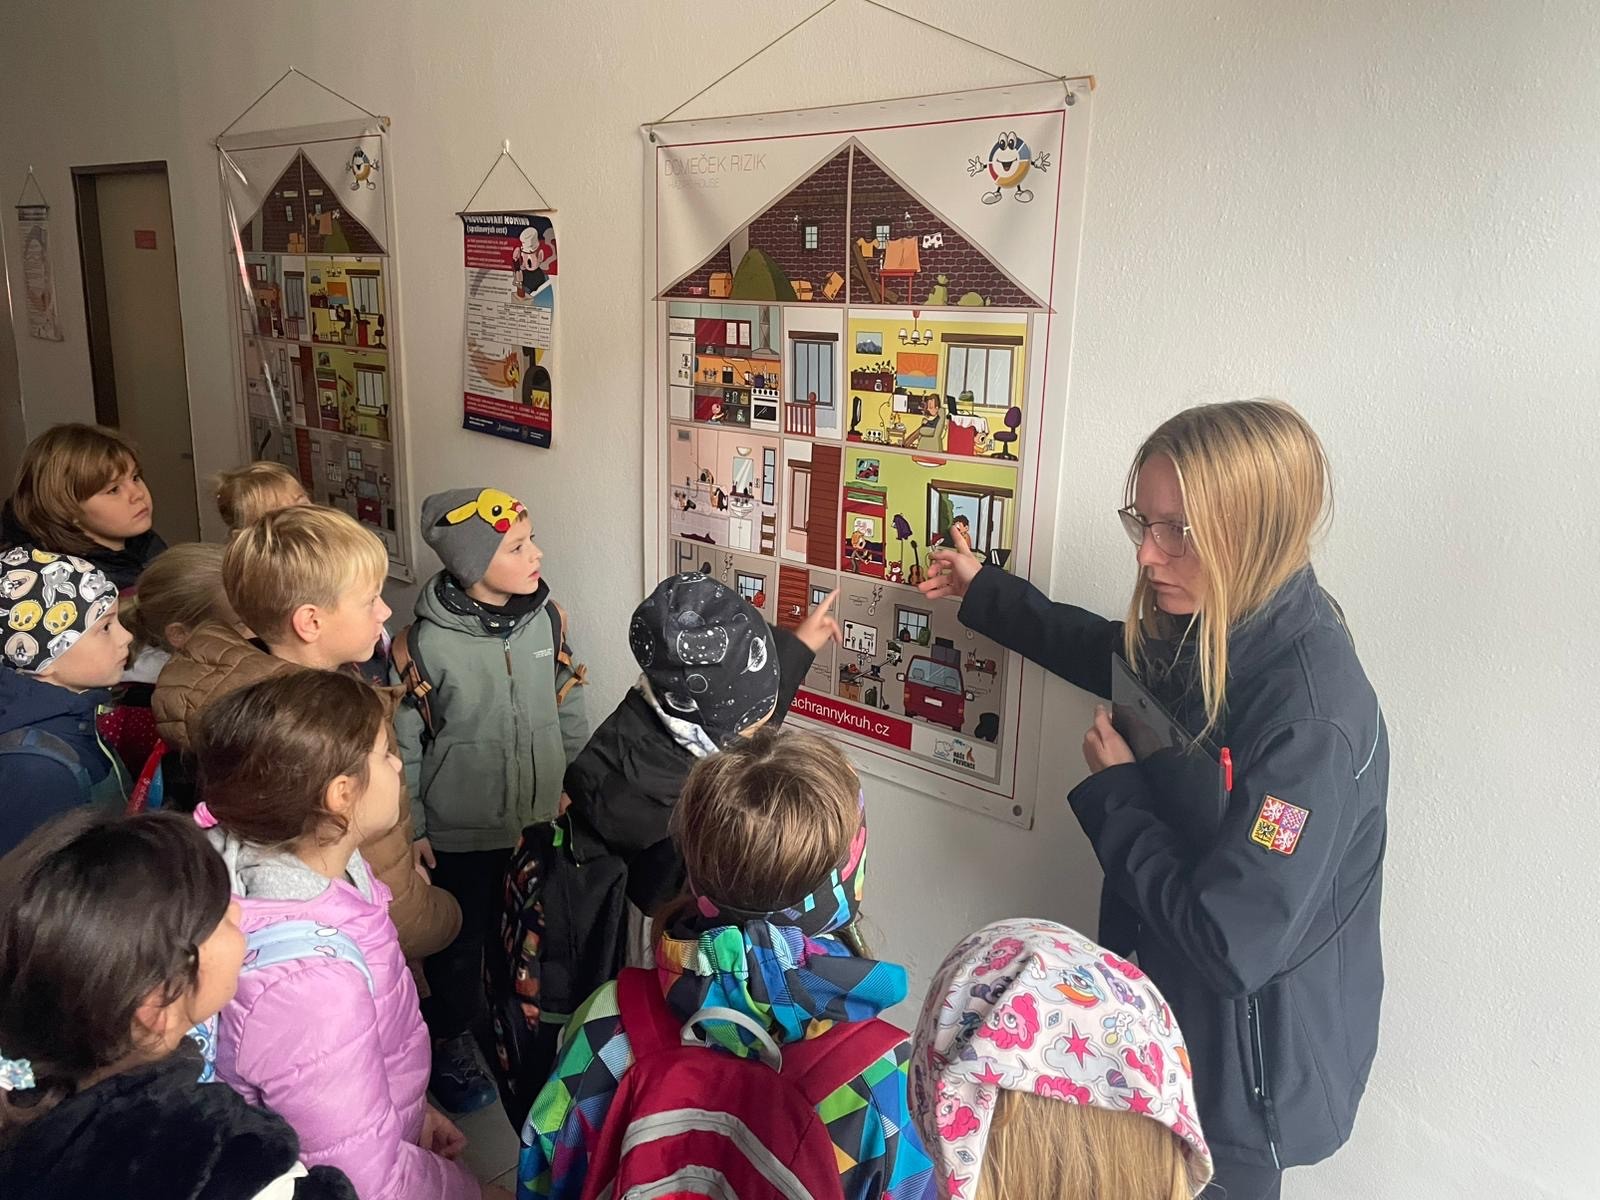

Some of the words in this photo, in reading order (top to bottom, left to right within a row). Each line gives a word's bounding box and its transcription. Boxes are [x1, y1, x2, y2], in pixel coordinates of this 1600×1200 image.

[664, 153, 727, 176] DOMEČEK
[730, 153, 767, 172] RIZIK
[791, 697, 890, 737] achrannykruh.cz
